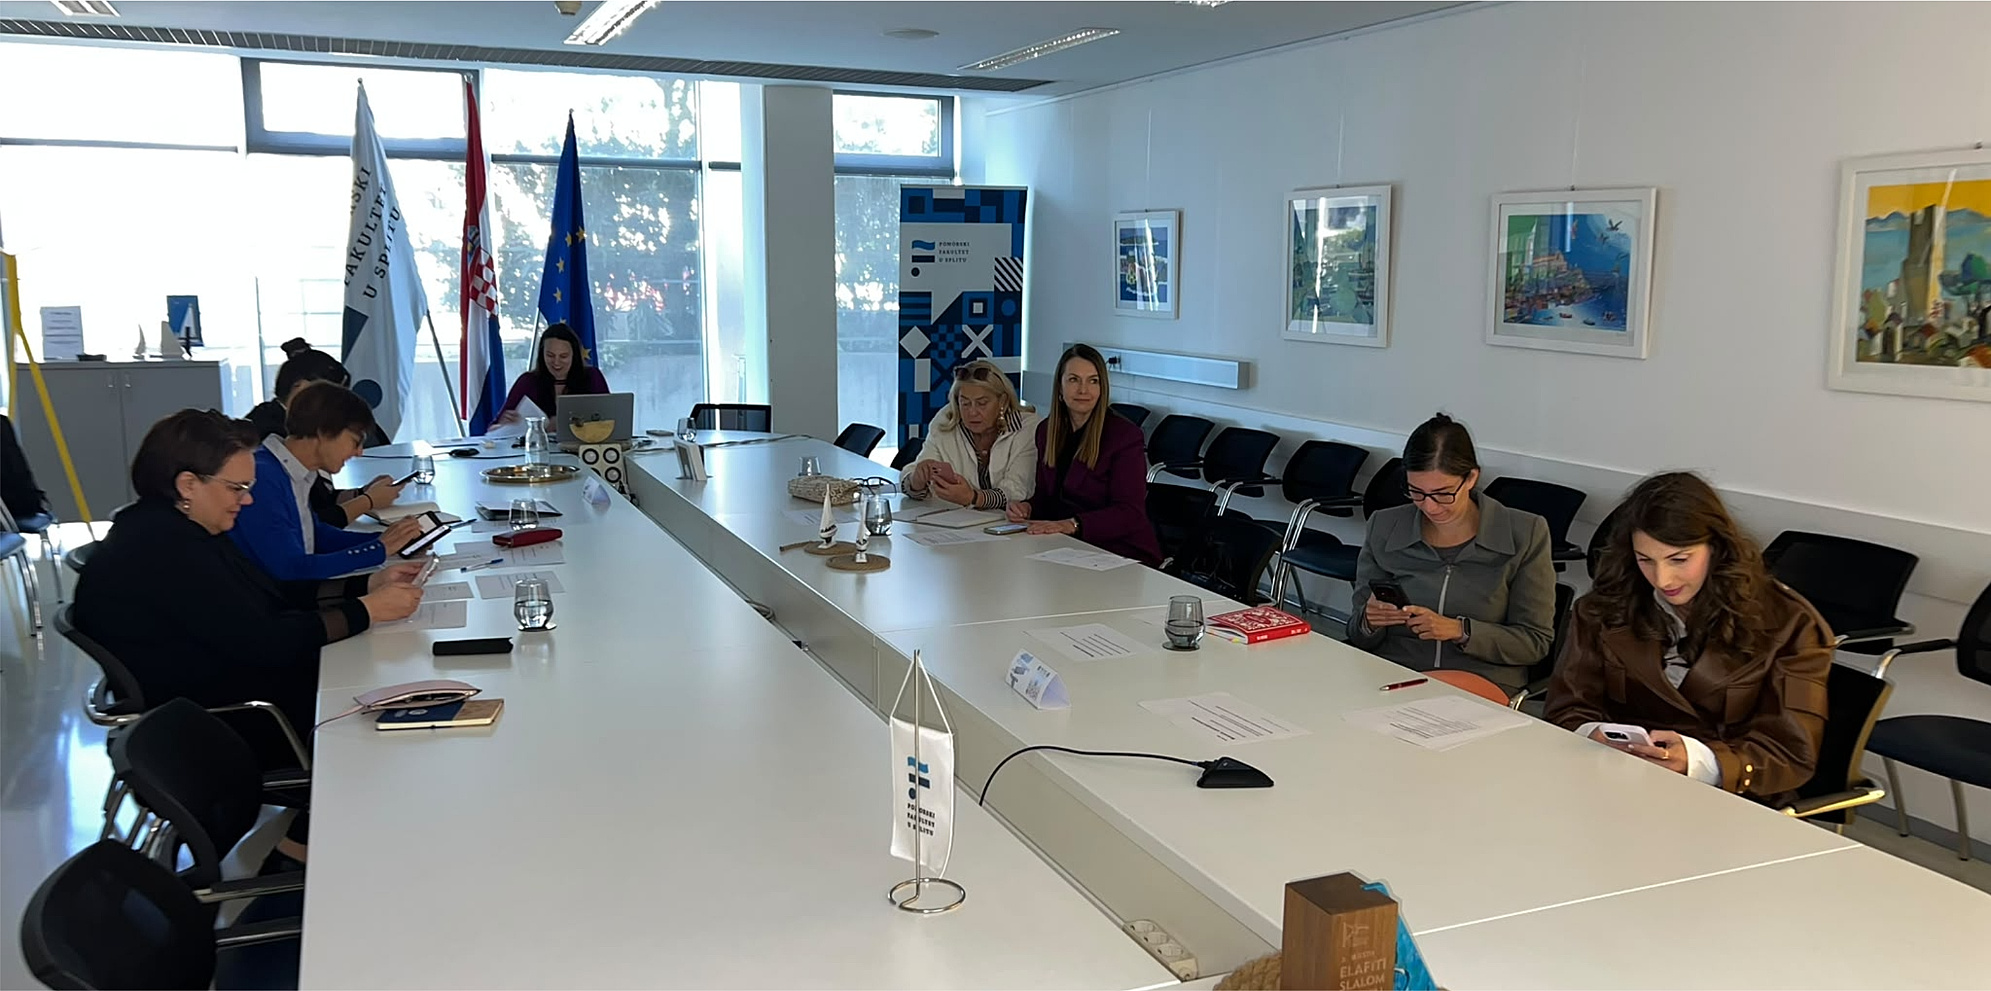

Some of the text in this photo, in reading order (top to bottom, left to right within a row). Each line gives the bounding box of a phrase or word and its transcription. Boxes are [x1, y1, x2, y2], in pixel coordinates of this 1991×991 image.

[363, 206, 400, 299] U SPLITU
[913, 824, 934, 836] SLITU
[1340, 957, 1387, 979] ELAFITI
[1340, 972, 1385, 990] SLALOM
